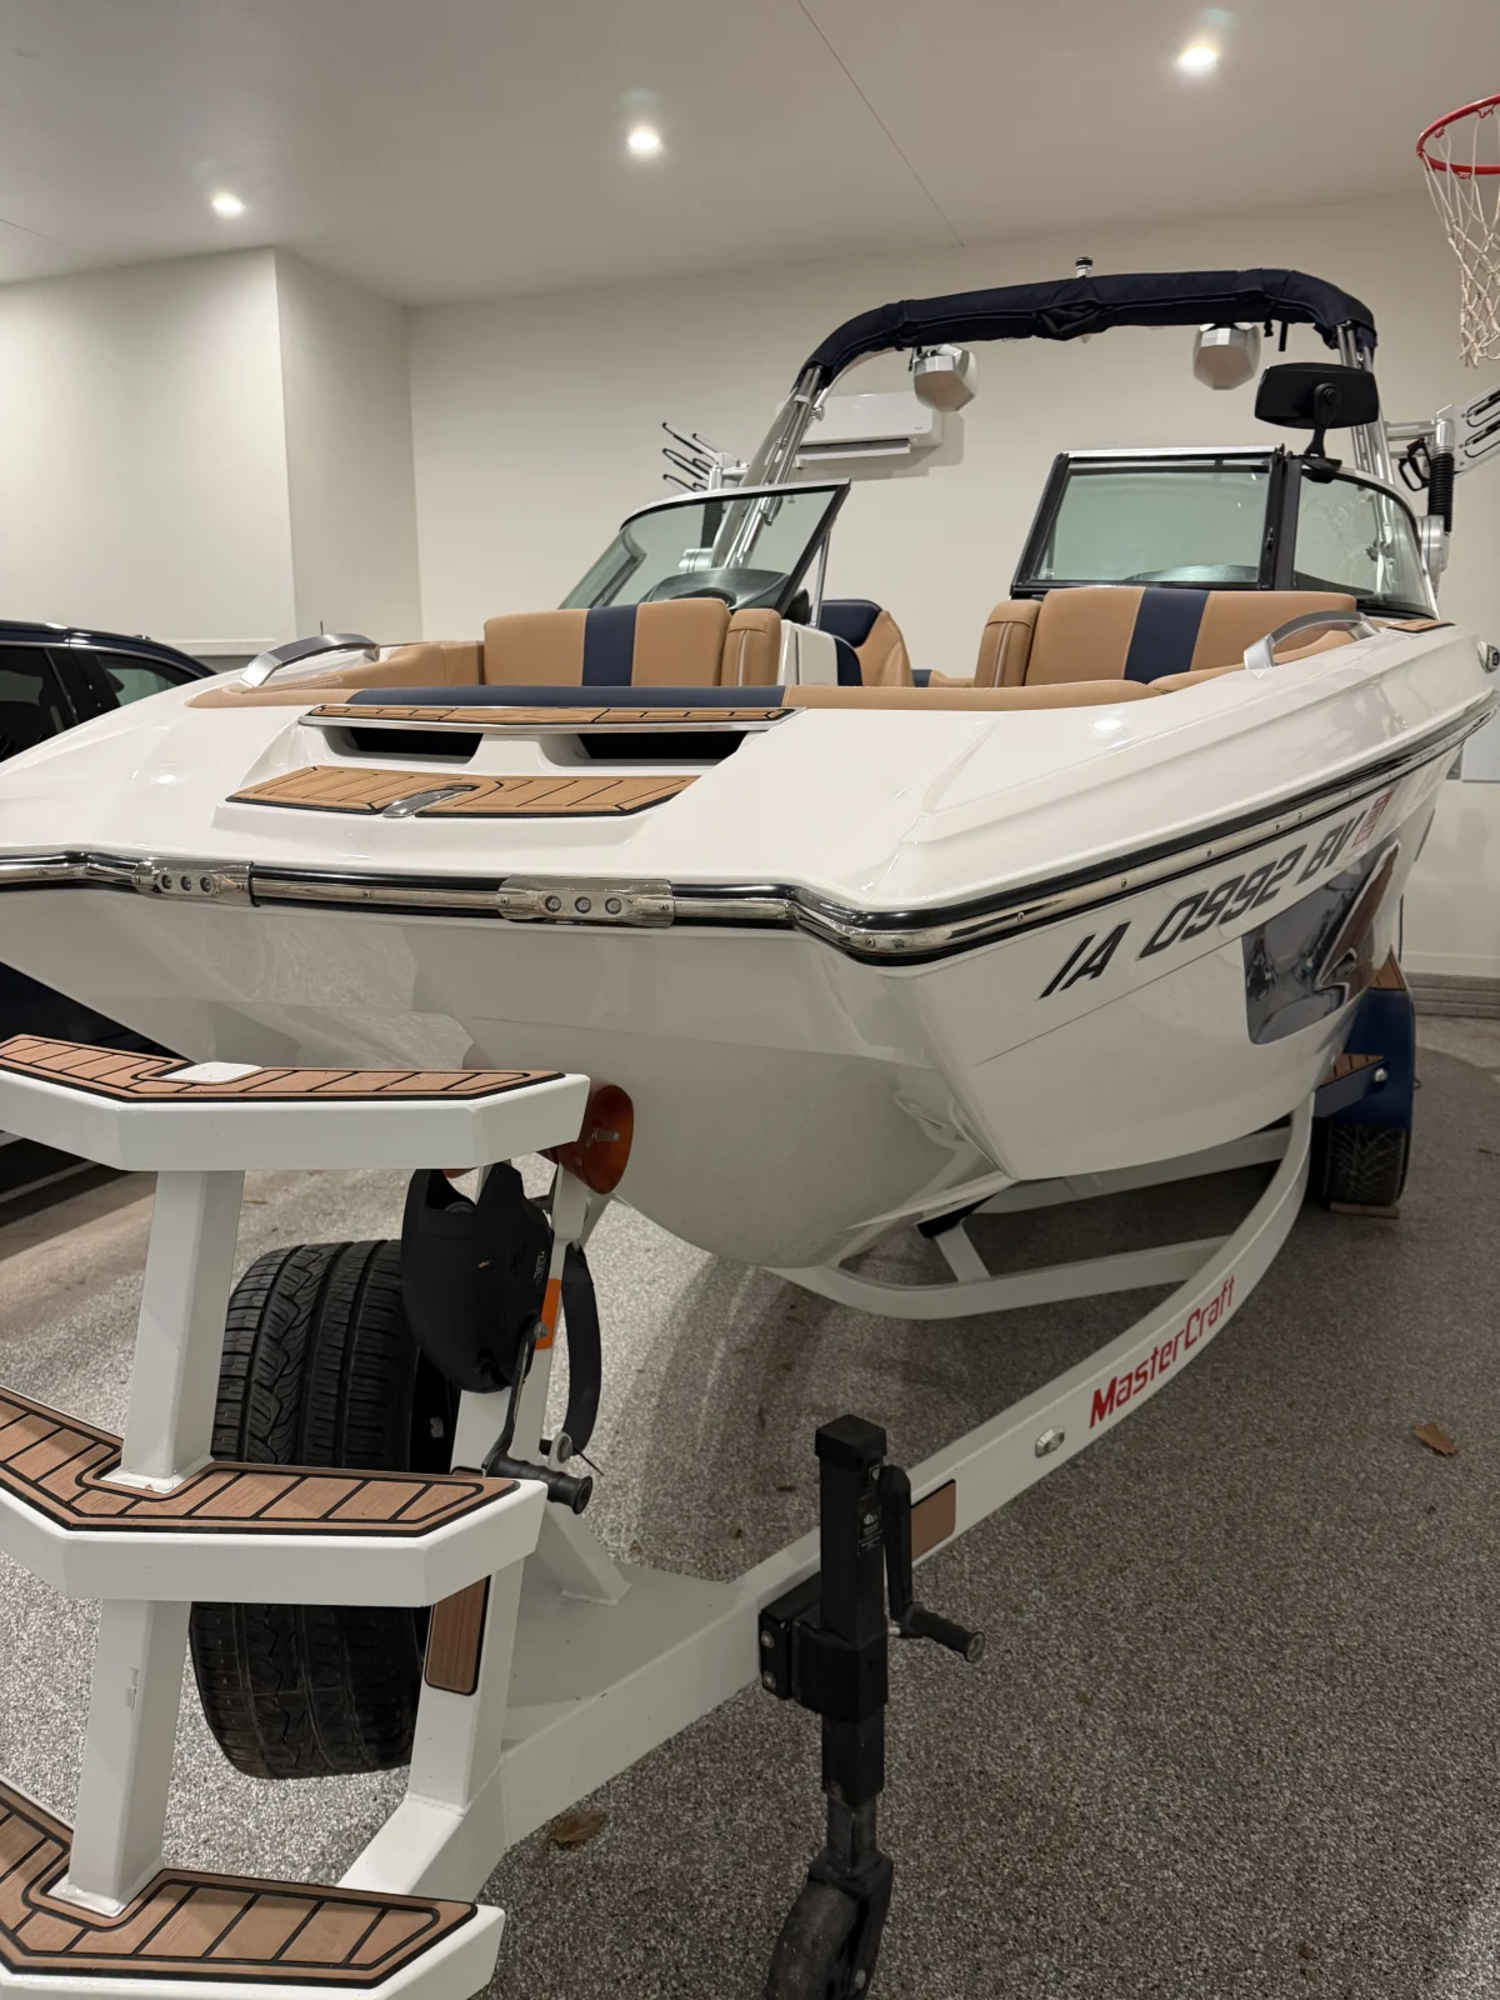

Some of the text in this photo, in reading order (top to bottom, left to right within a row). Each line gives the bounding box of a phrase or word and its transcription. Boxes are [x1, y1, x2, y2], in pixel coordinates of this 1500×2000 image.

[1039, 921, 1131, 999] IA
[1137, 844, 1308, 959] 0992
[1295, 809, 1368, 886] BV
[1089, 1275, 1235, 1430] MasterCraft
